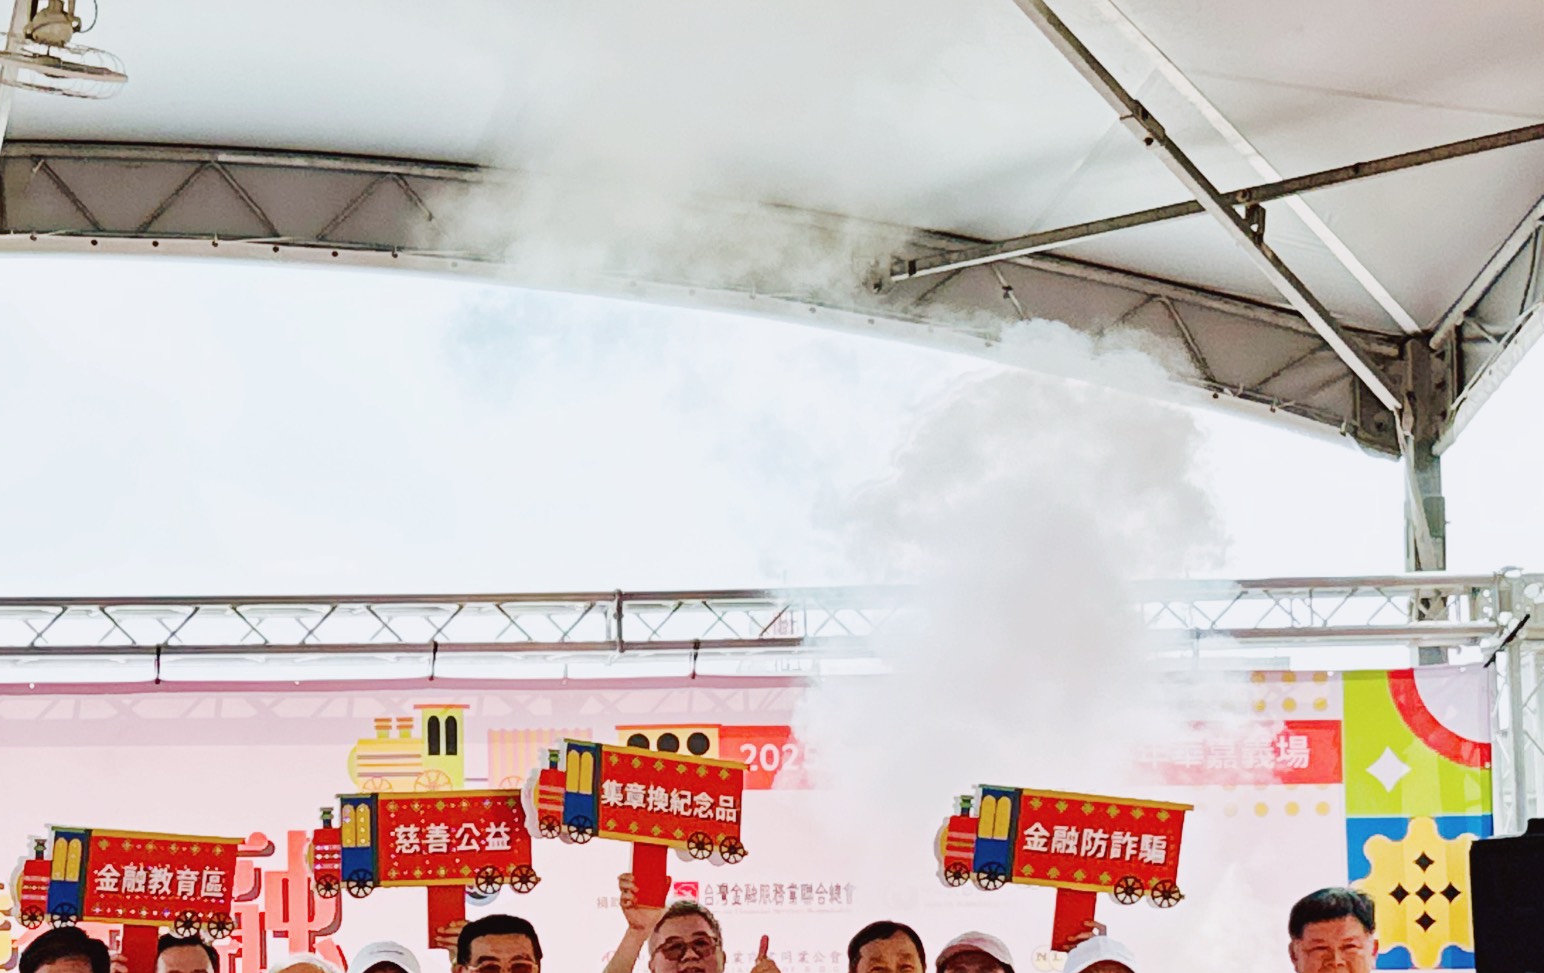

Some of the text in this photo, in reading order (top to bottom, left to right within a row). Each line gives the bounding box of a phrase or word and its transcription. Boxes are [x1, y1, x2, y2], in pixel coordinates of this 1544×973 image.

[602, 780, 736, 822] 集章換紀念品
[395, 823, 510, 853] 慈善公益
[1024, 823, 1166, 863] 金融防詐騙
[95, 864, 224, 897] 金融教育區
[704, 882, 856, 906] 台灣金融服務業聯合總會
